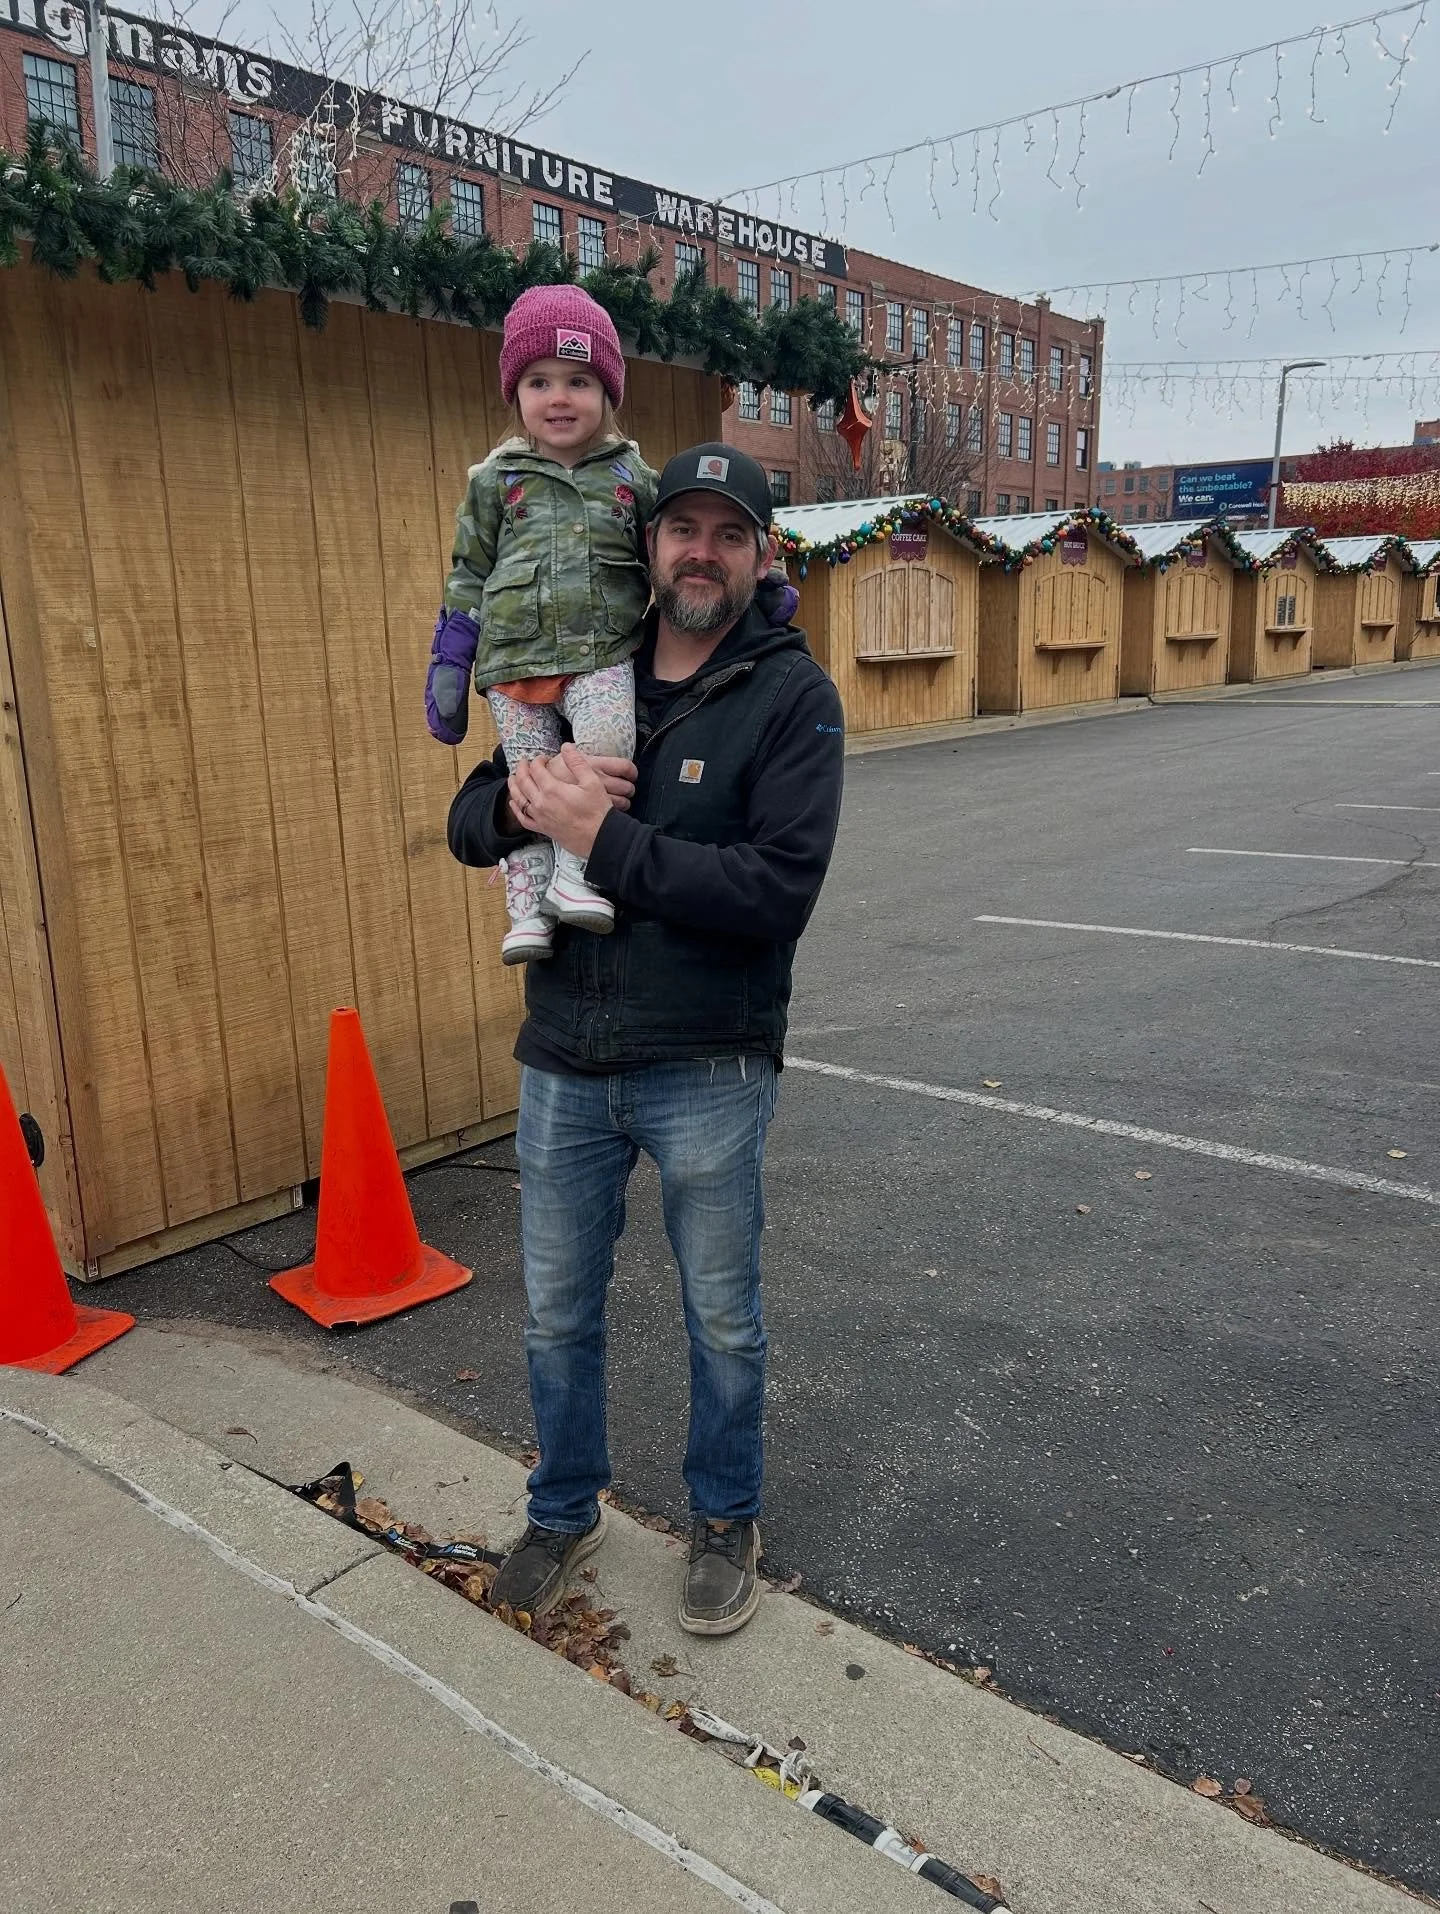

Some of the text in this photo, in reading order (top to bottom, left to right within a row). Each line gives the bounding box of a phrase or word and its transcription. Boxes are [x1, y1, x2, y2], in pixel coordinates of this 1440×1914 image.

[381, 100, 614, 206] FURNITURE
[655, 191, 827, 269] WAREHOUSE
[1179, 476, 1197, 484] Can
[1214, 472, 1236, 481] beat
[1179, 481, 1253, 493] the unbeatable?
[1178, 495, 1194, 503] We
[891, 533, 927, 542] COFFEE CAKE
